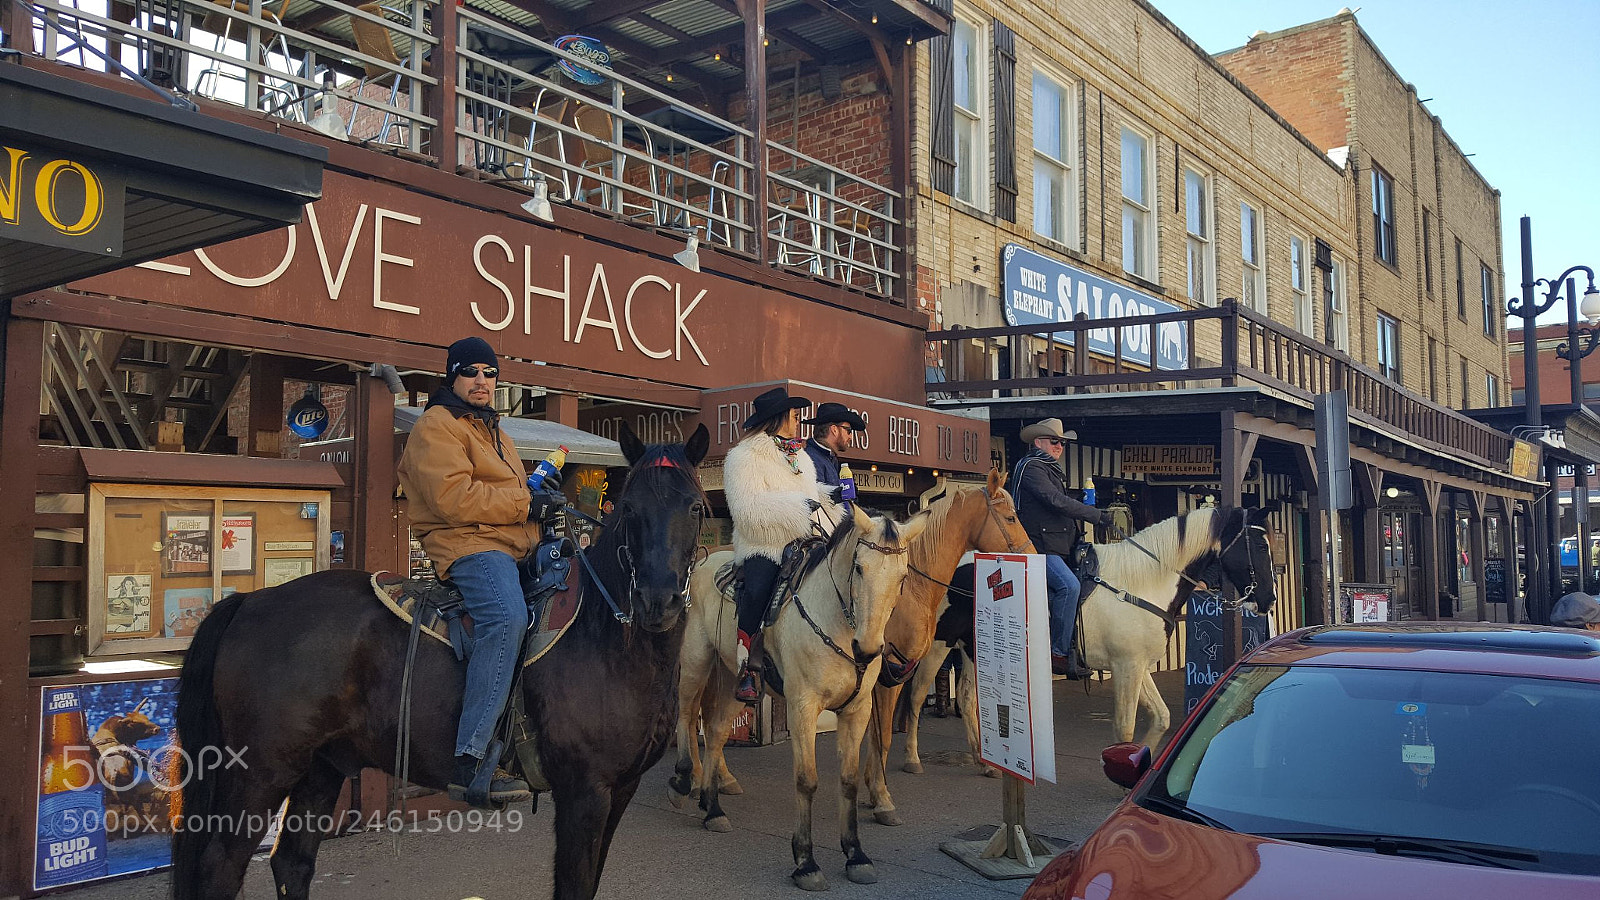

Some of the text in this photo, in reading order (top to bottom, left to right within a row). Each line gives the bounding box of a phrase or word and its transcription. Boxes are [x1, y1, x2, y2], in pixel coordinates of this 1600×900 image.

[134, 203, 709, 367] OVE SHACK
[1020, 267, 1047, 293] WHITE
[1013, 290, 1053, 320] ELEPHANT
[1057, 274, 1156, 355] SALOON
[591, 410, 684, 443] HOT DOGS
[889, 415, 921, 457] BEER
[937, 424, 953, 460] TO
[964, 429, 979, 464] GO
[1123, 447, 1213, 464] CHILI PARLOR
[853, 473, 870, 487] EER
[873, 474, 885, 488] TO
[888, 475, 901, 489] GO
[49, 699, 79, 710] LIGHT
[52, 692, 75, 702] BUD
[731, 711, 749, 735] quet
[44, 846, 98, 872] LIGHT
[50, 836, 90, 857] BUD
